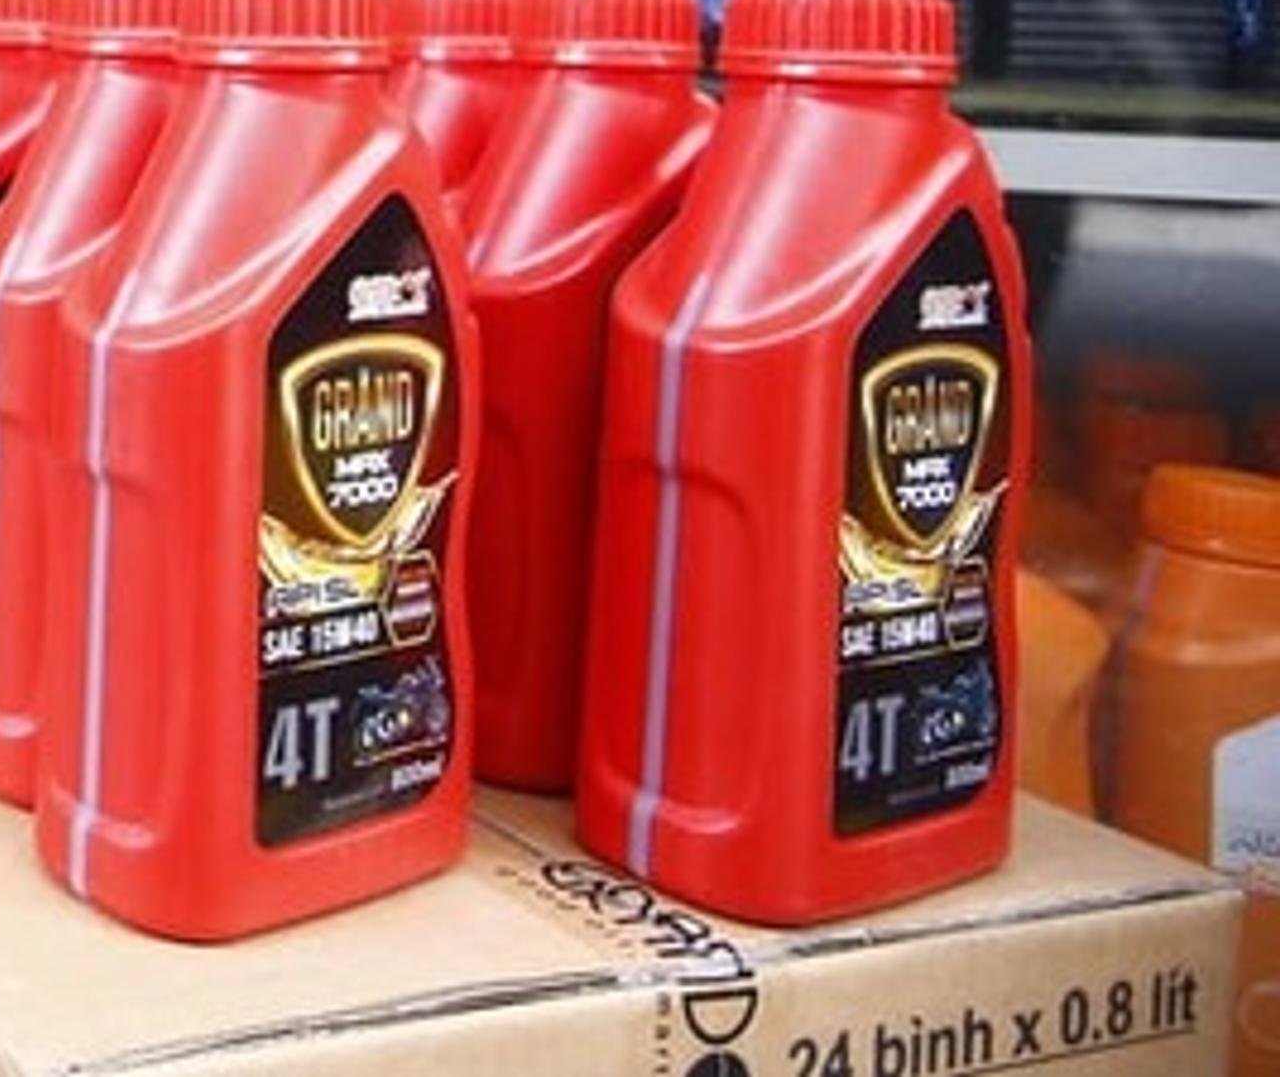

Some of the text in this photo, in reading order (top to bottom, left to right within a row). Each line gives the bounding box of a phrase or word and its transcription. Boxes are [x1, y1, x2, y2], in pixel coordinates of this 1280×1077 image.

[313, 368, 415, 452] GRAND
[884, 375, 973, 455] GRAND
[329, 475, 398, 508] 7000
[895, 481, 958, 512] 7000
[262, 626, 303, 664] SAE
[263, 696, 341, 789] 4T
[840, 692, 907, 781] 4T
[789, 1029, 855, 1077] 24
[1012, 1010, 1042, 1056] x
[1060, 979, 1135, 1046] 0.8
